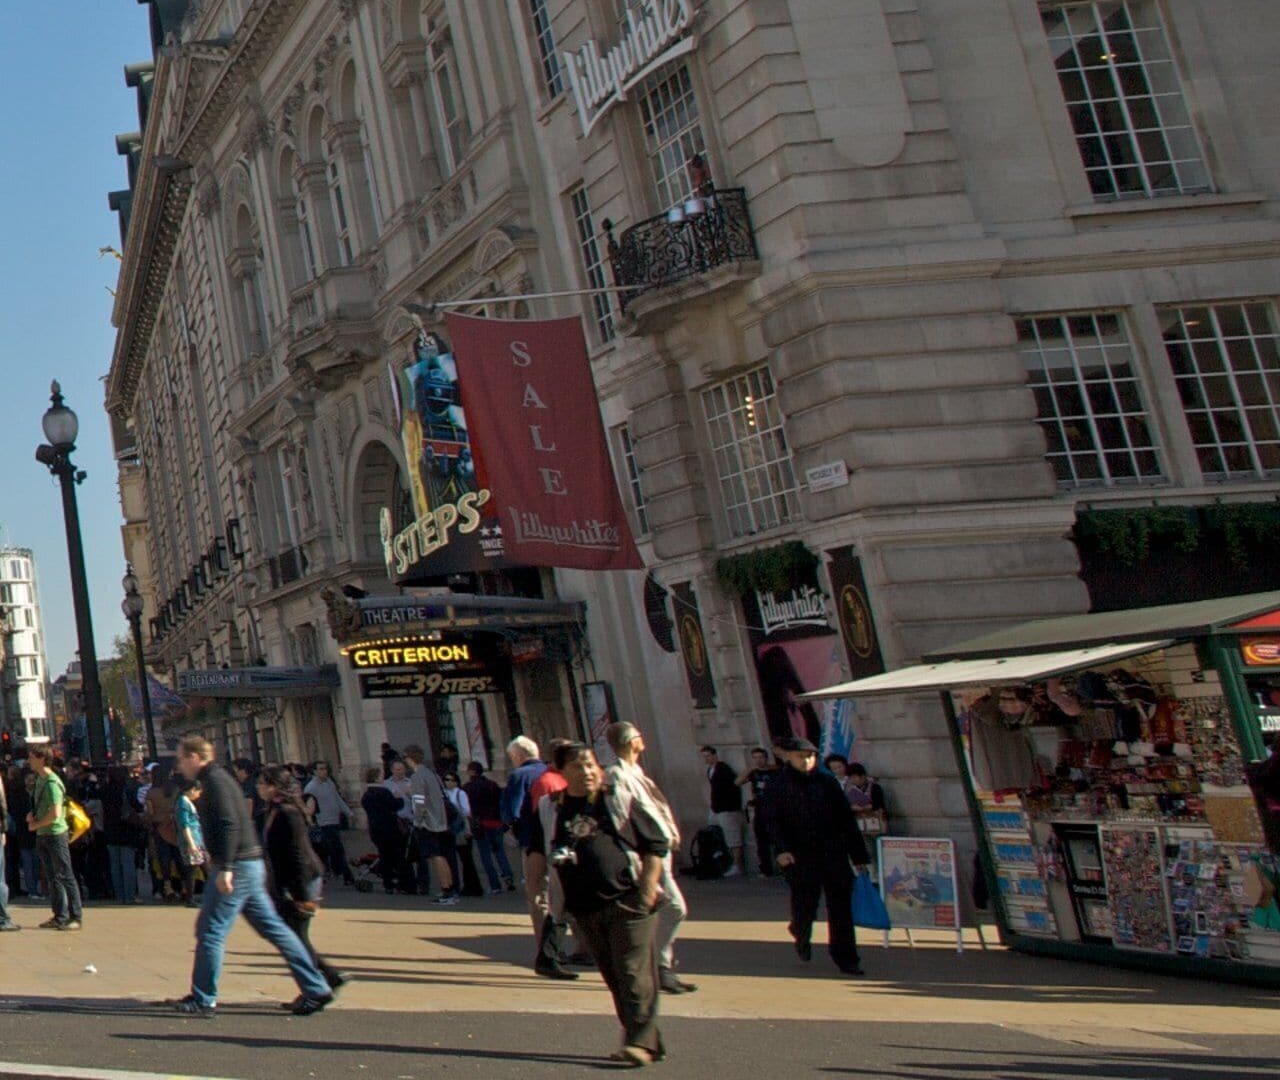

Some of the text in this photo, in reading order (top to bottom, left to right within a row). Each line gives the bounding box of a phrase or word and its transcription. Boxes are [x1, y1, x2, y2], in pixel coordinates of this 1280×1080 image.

[509, 340, 568, 495] SALE
[508, 506, 621, 552] Lillywhites
[364, 607, 428, 625] THEATRE
[755, 584, 828, 635] Lillywhites
[354, 644, 470, 667] CRITERION
[409, 673, 443, 696] 39
